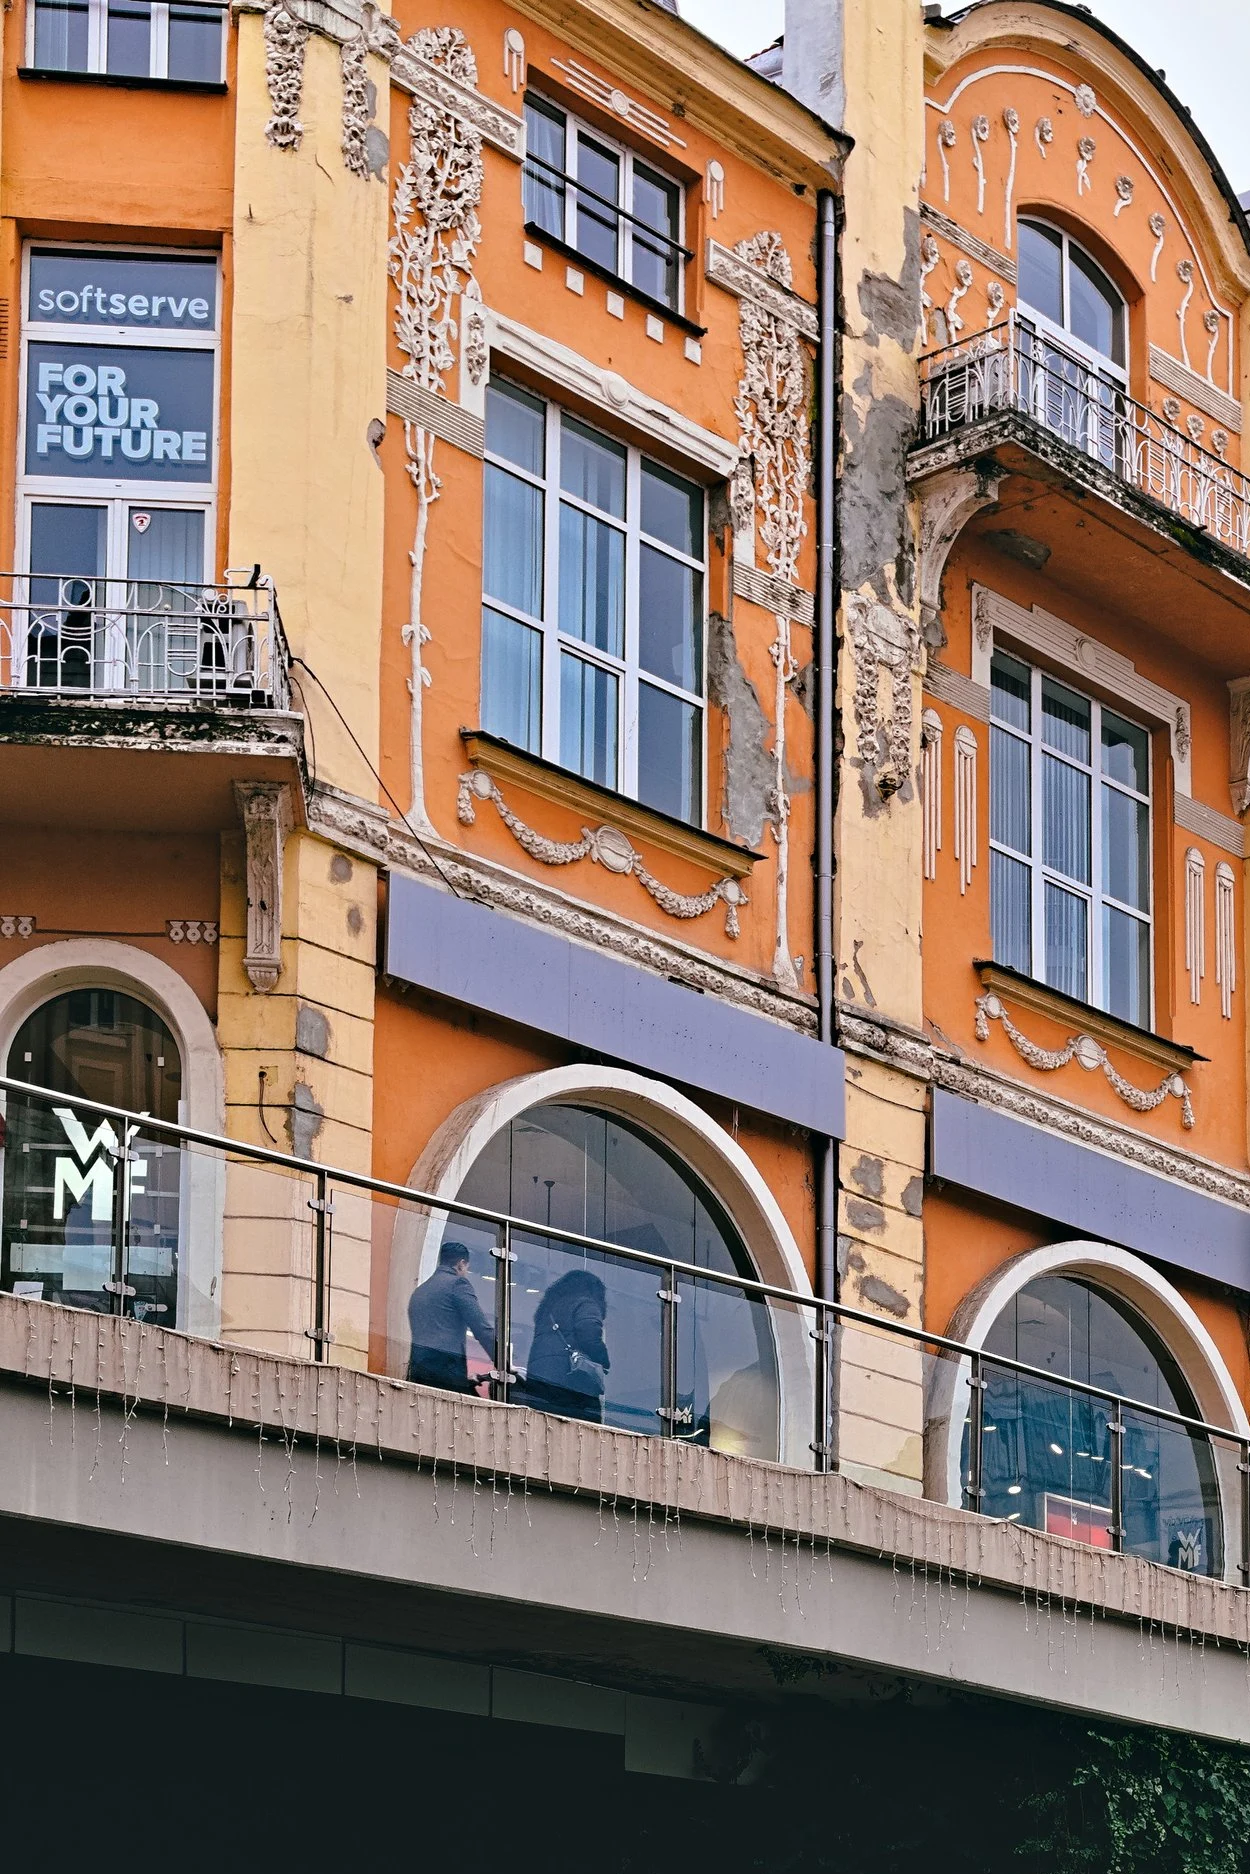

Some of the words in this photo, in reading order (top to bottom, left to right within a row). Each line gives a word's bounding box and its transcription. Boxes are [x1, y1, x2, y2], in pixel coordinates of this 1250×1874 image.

[38, 284, 209, 319] softserve
[38, 362, 126, 397] FOR
[36, 393, 159, 429] YOUR
[36, 423, 207, 462] FUTURE
